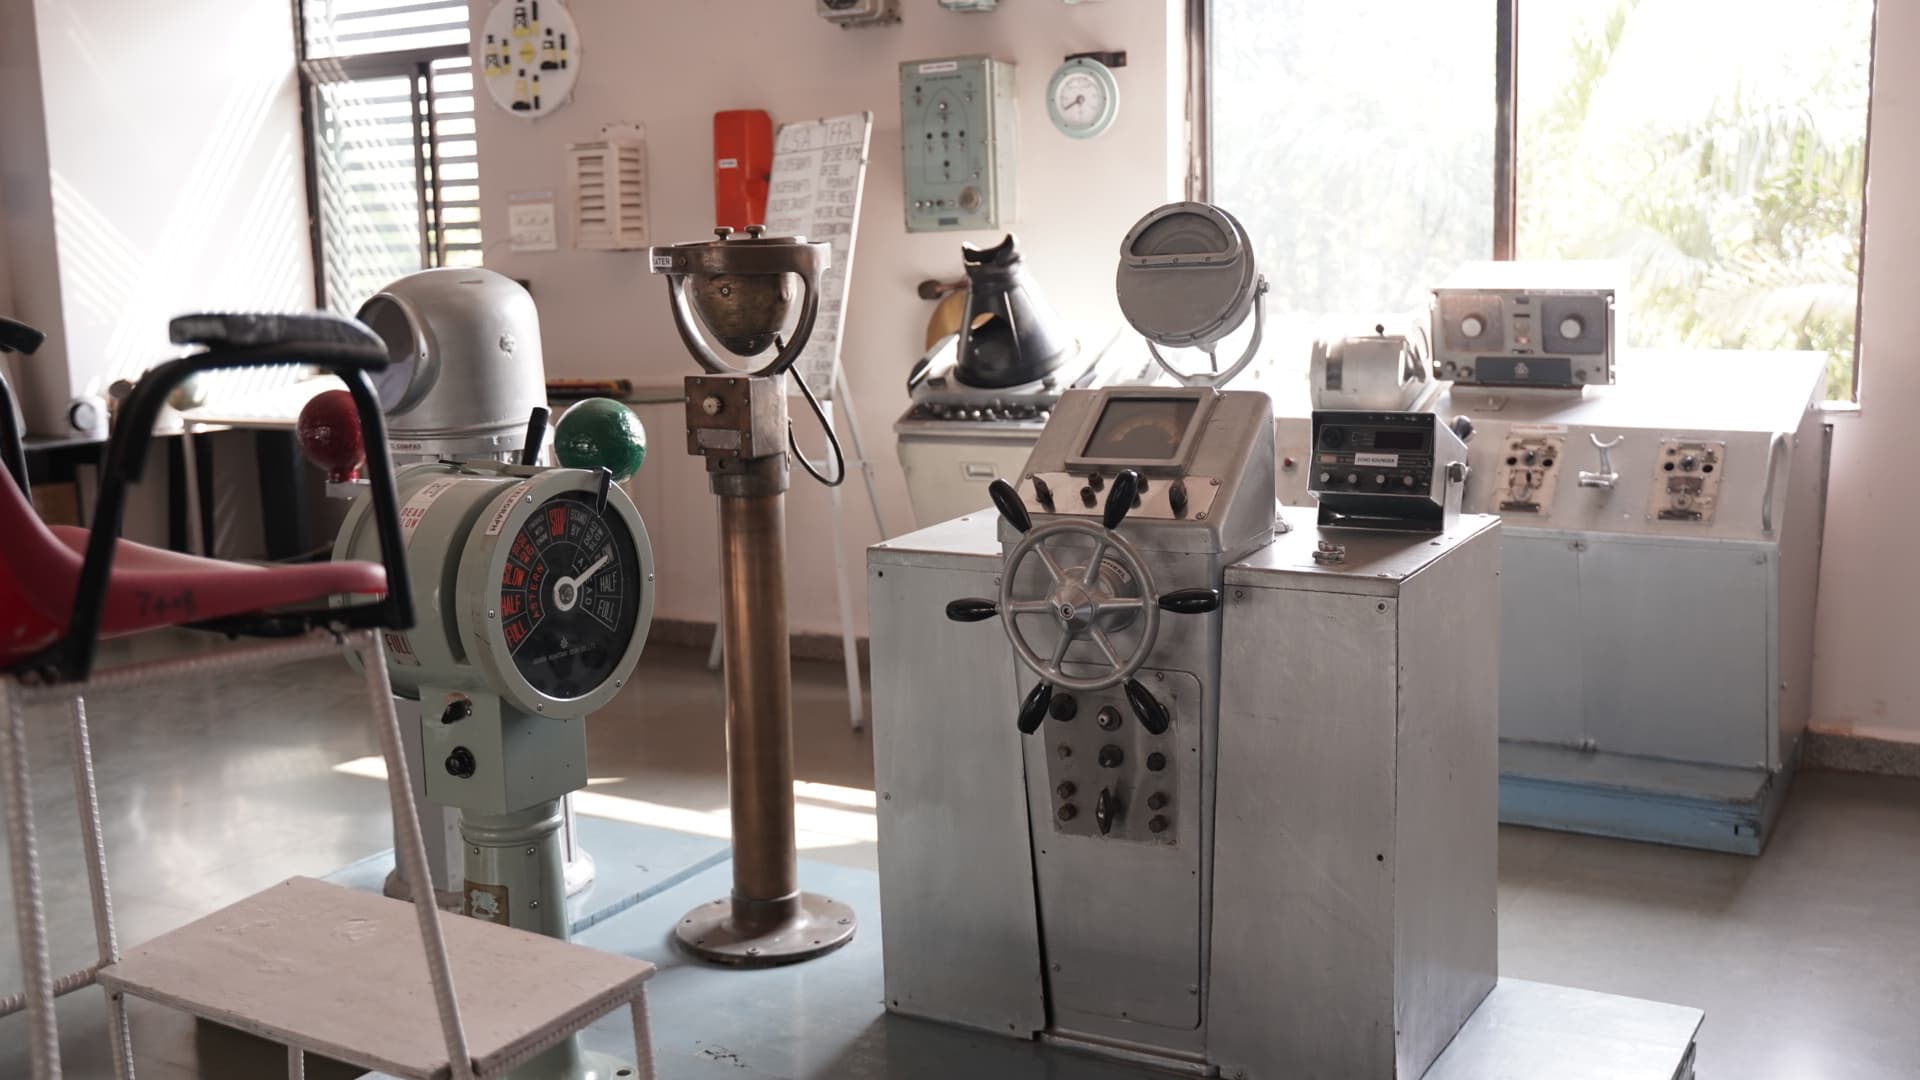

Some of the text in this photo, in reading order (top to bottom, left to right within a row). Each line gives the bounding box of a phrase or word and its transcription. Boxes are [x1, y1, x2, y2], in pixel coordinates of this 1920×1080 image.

[548, 507, 567, 537] STOP
[570, 525, 581, 537] BY
[584, 520, 598, 546] DEAD
[503, 562, 526, 587] SLOW
[599, 571, 617, 593] HALF
[501, 593, 522, 617] HALF
[597, 600, 617, 624] FULL
[385, 632, 413, 655] FULL
[504, 620, 528, 648] FULL
